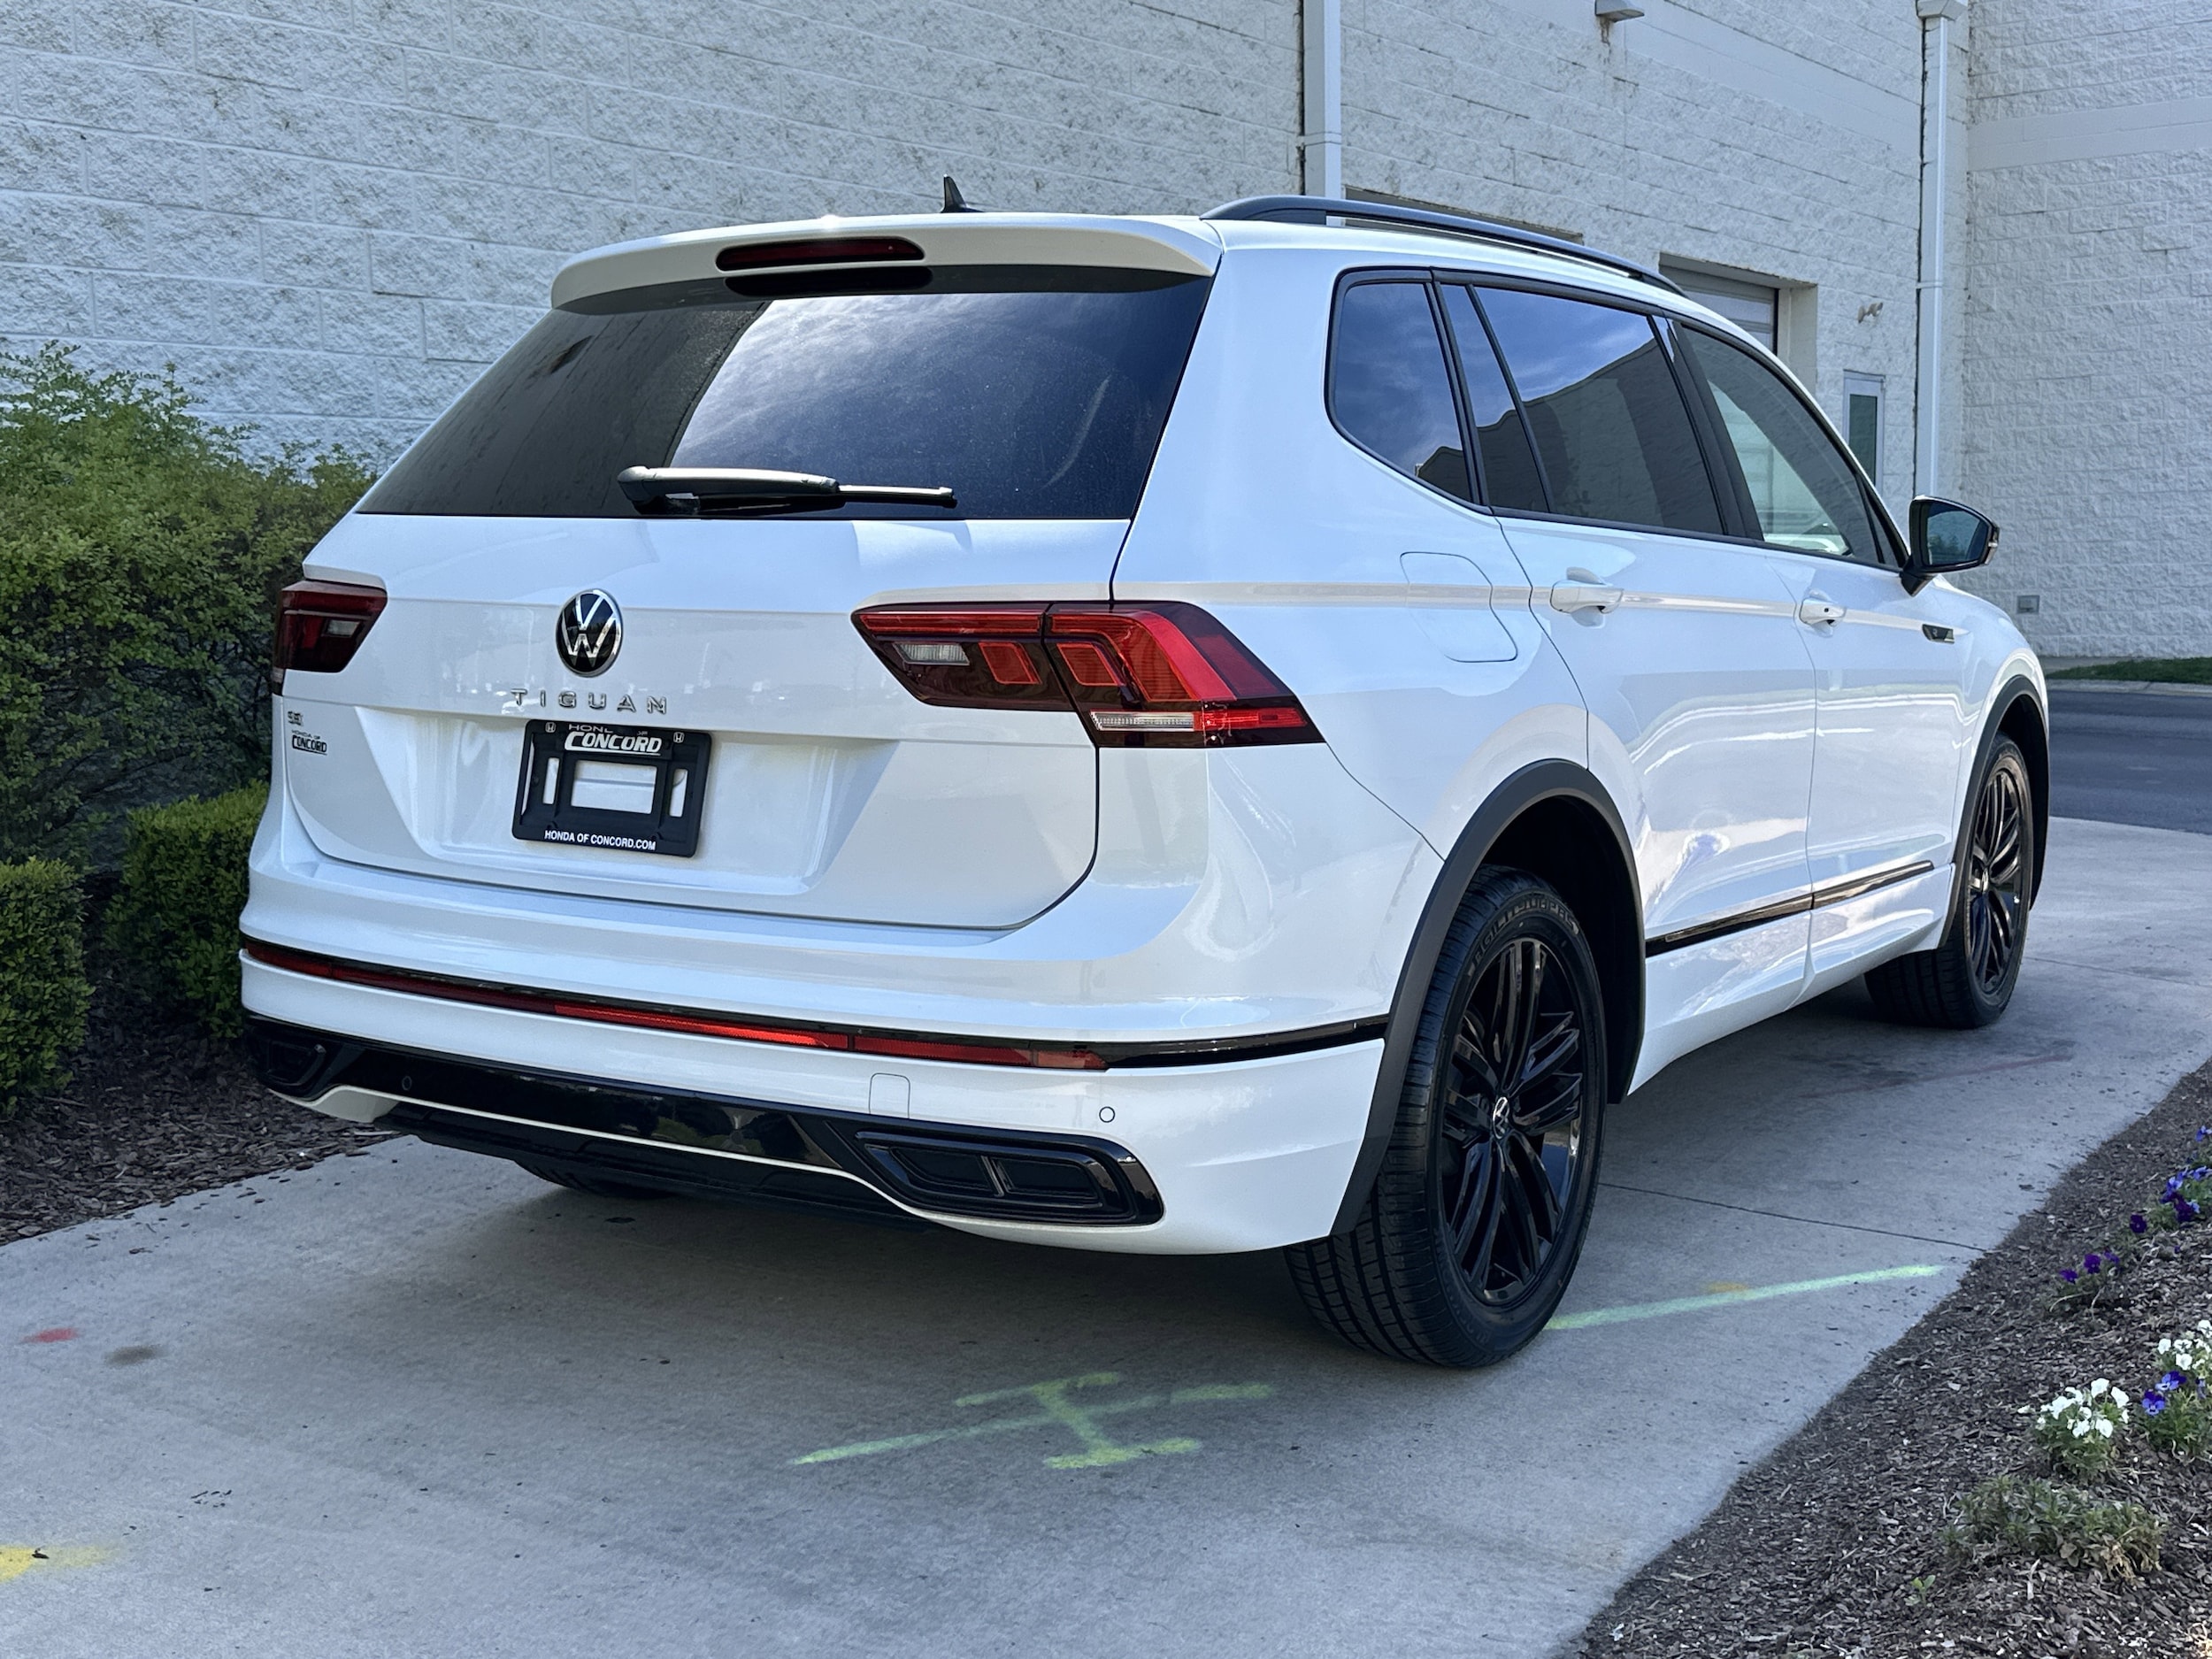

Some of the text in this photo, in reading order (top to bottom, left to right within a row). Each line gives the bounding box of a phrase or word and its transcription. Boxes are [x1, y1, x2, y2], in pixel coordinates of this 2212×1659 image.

[510, 687, 667, 715] TIGUAN
[292, 734, 327, 755] CONCORD
[564, 730, 663, 756] CONCORD
[543, 830, 657, 851] HONDA OF CONCORD.COM
